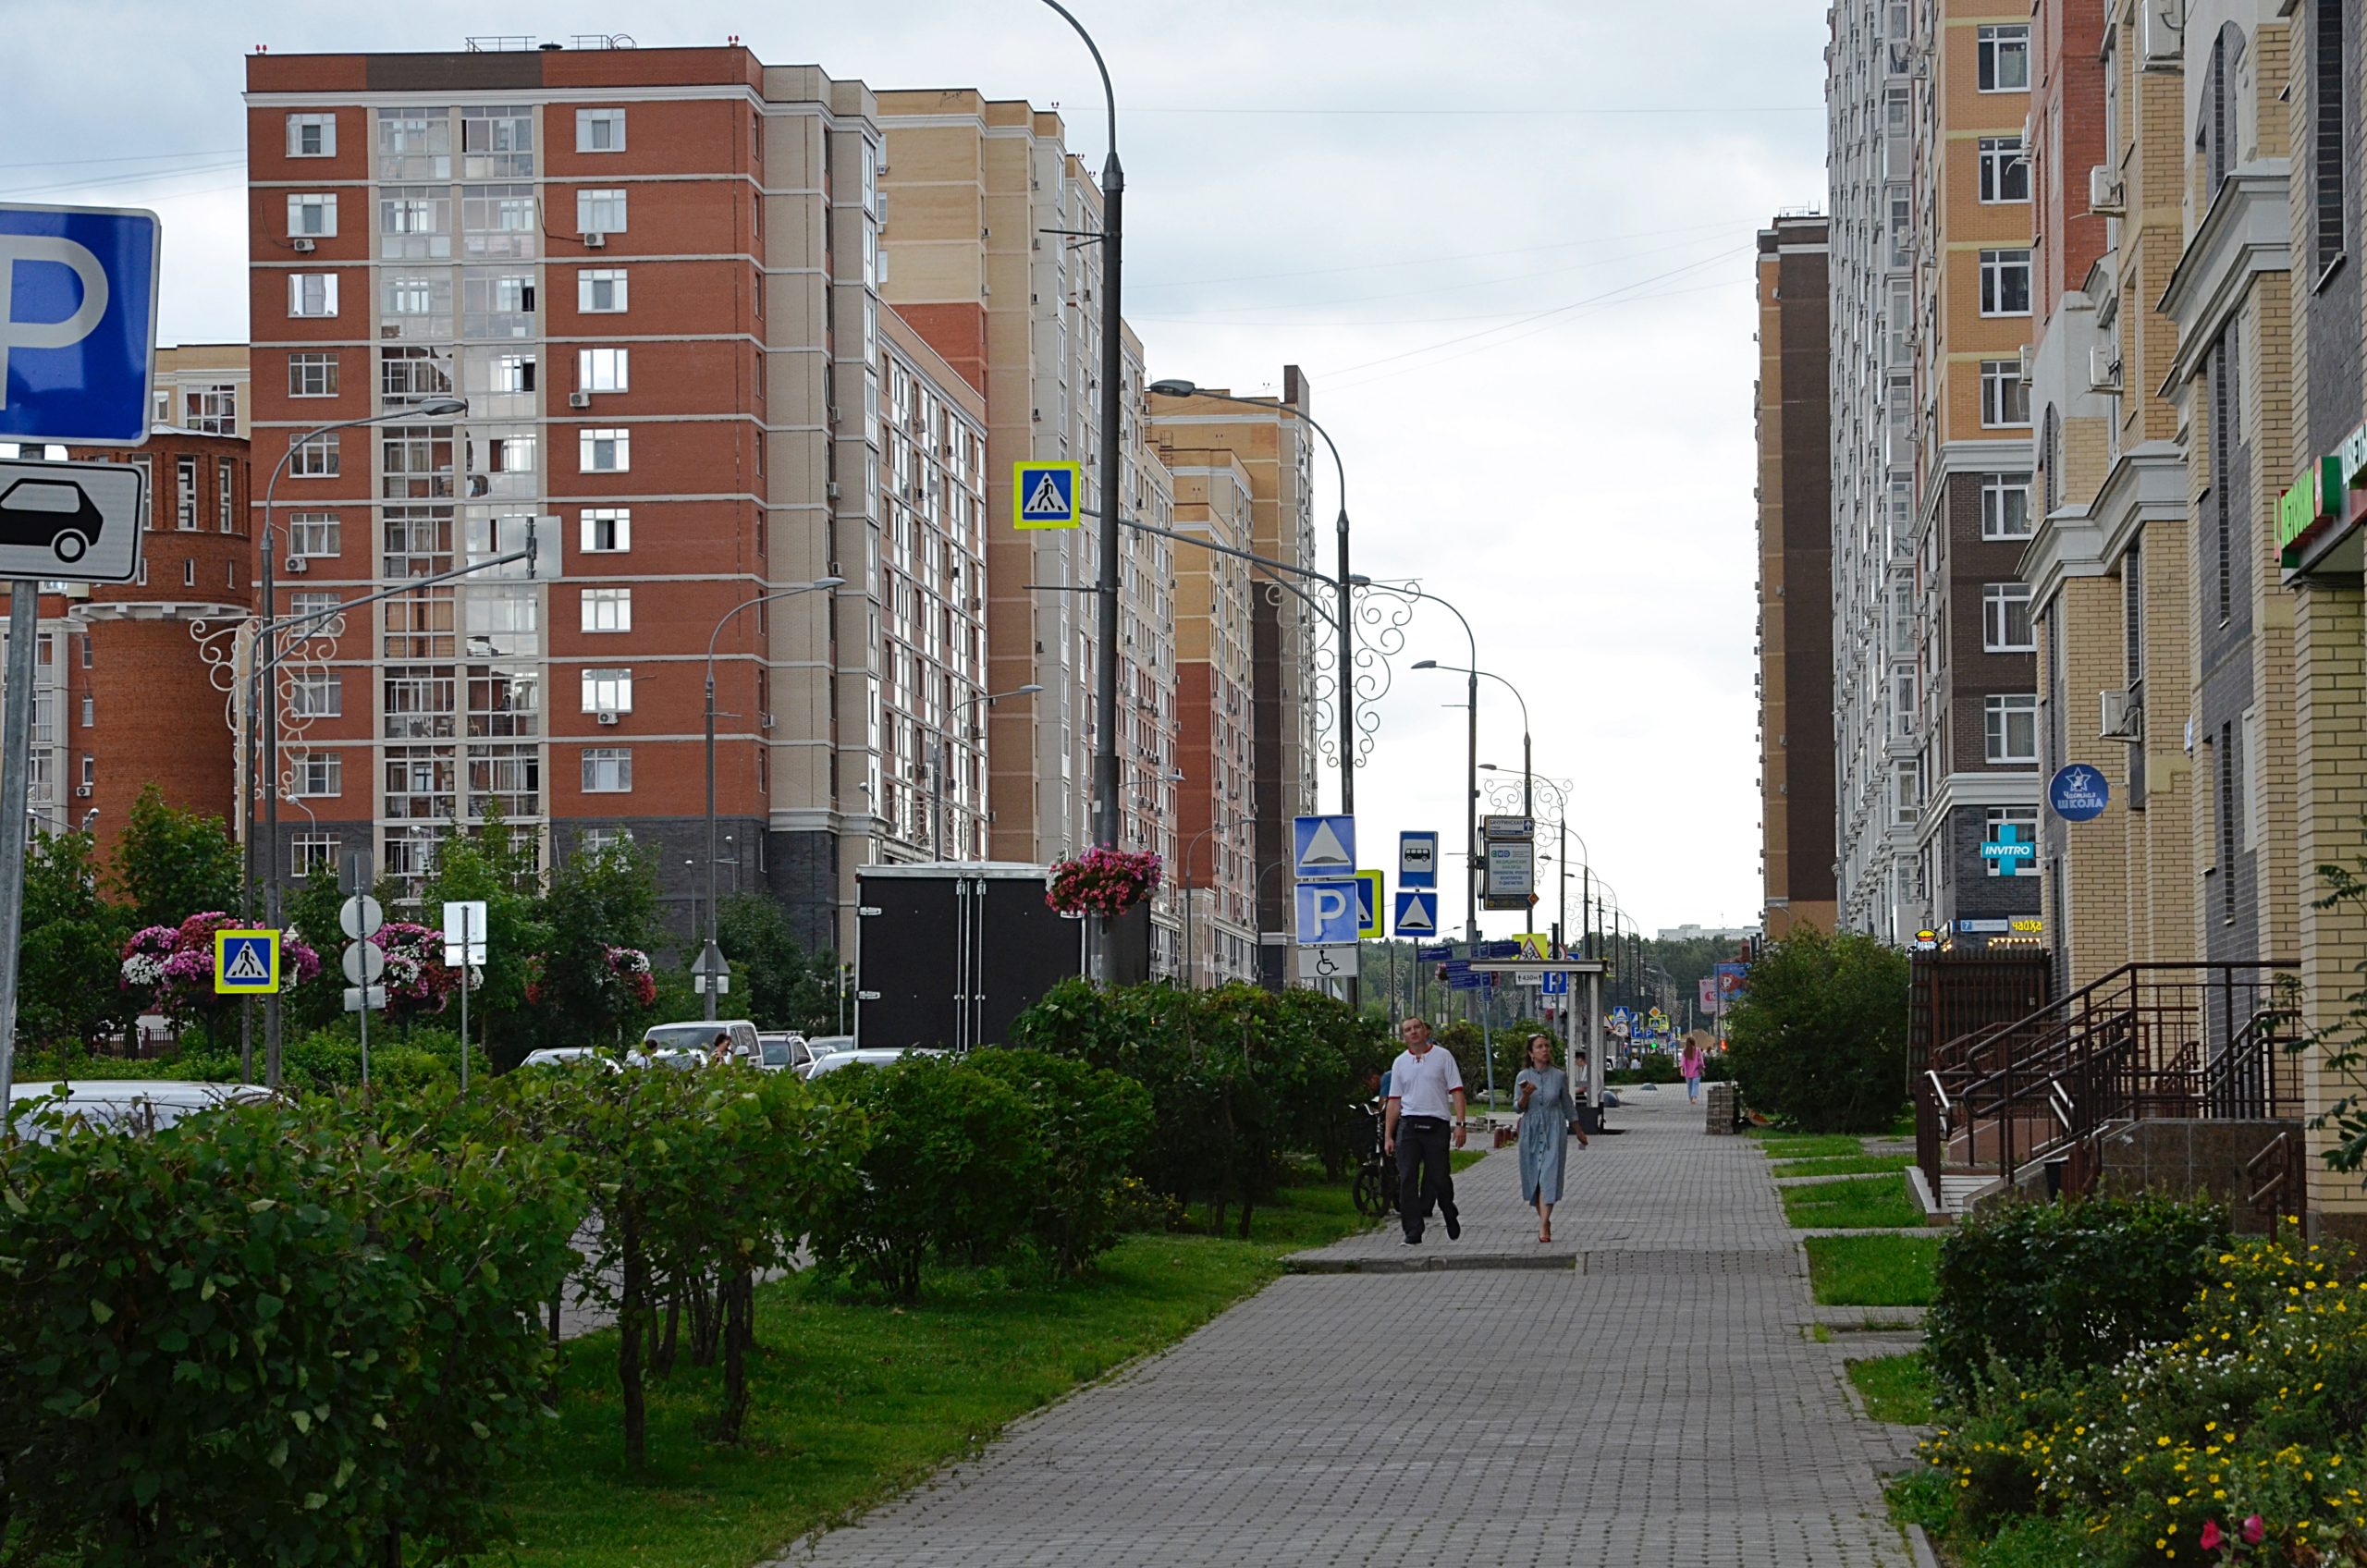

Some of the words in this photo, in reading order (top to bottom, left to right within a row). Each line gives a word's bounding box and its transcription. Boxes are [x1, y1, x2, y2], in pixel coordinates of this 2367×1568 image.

[0, 234, 109, 412] P
[2063, 790, 2097, 799] Частная
[2057, 798, 2103, 809] ШКОЛА
[1984, 845, 2030, 855] INVITRO
[1313, 889, 1346, 937] P
